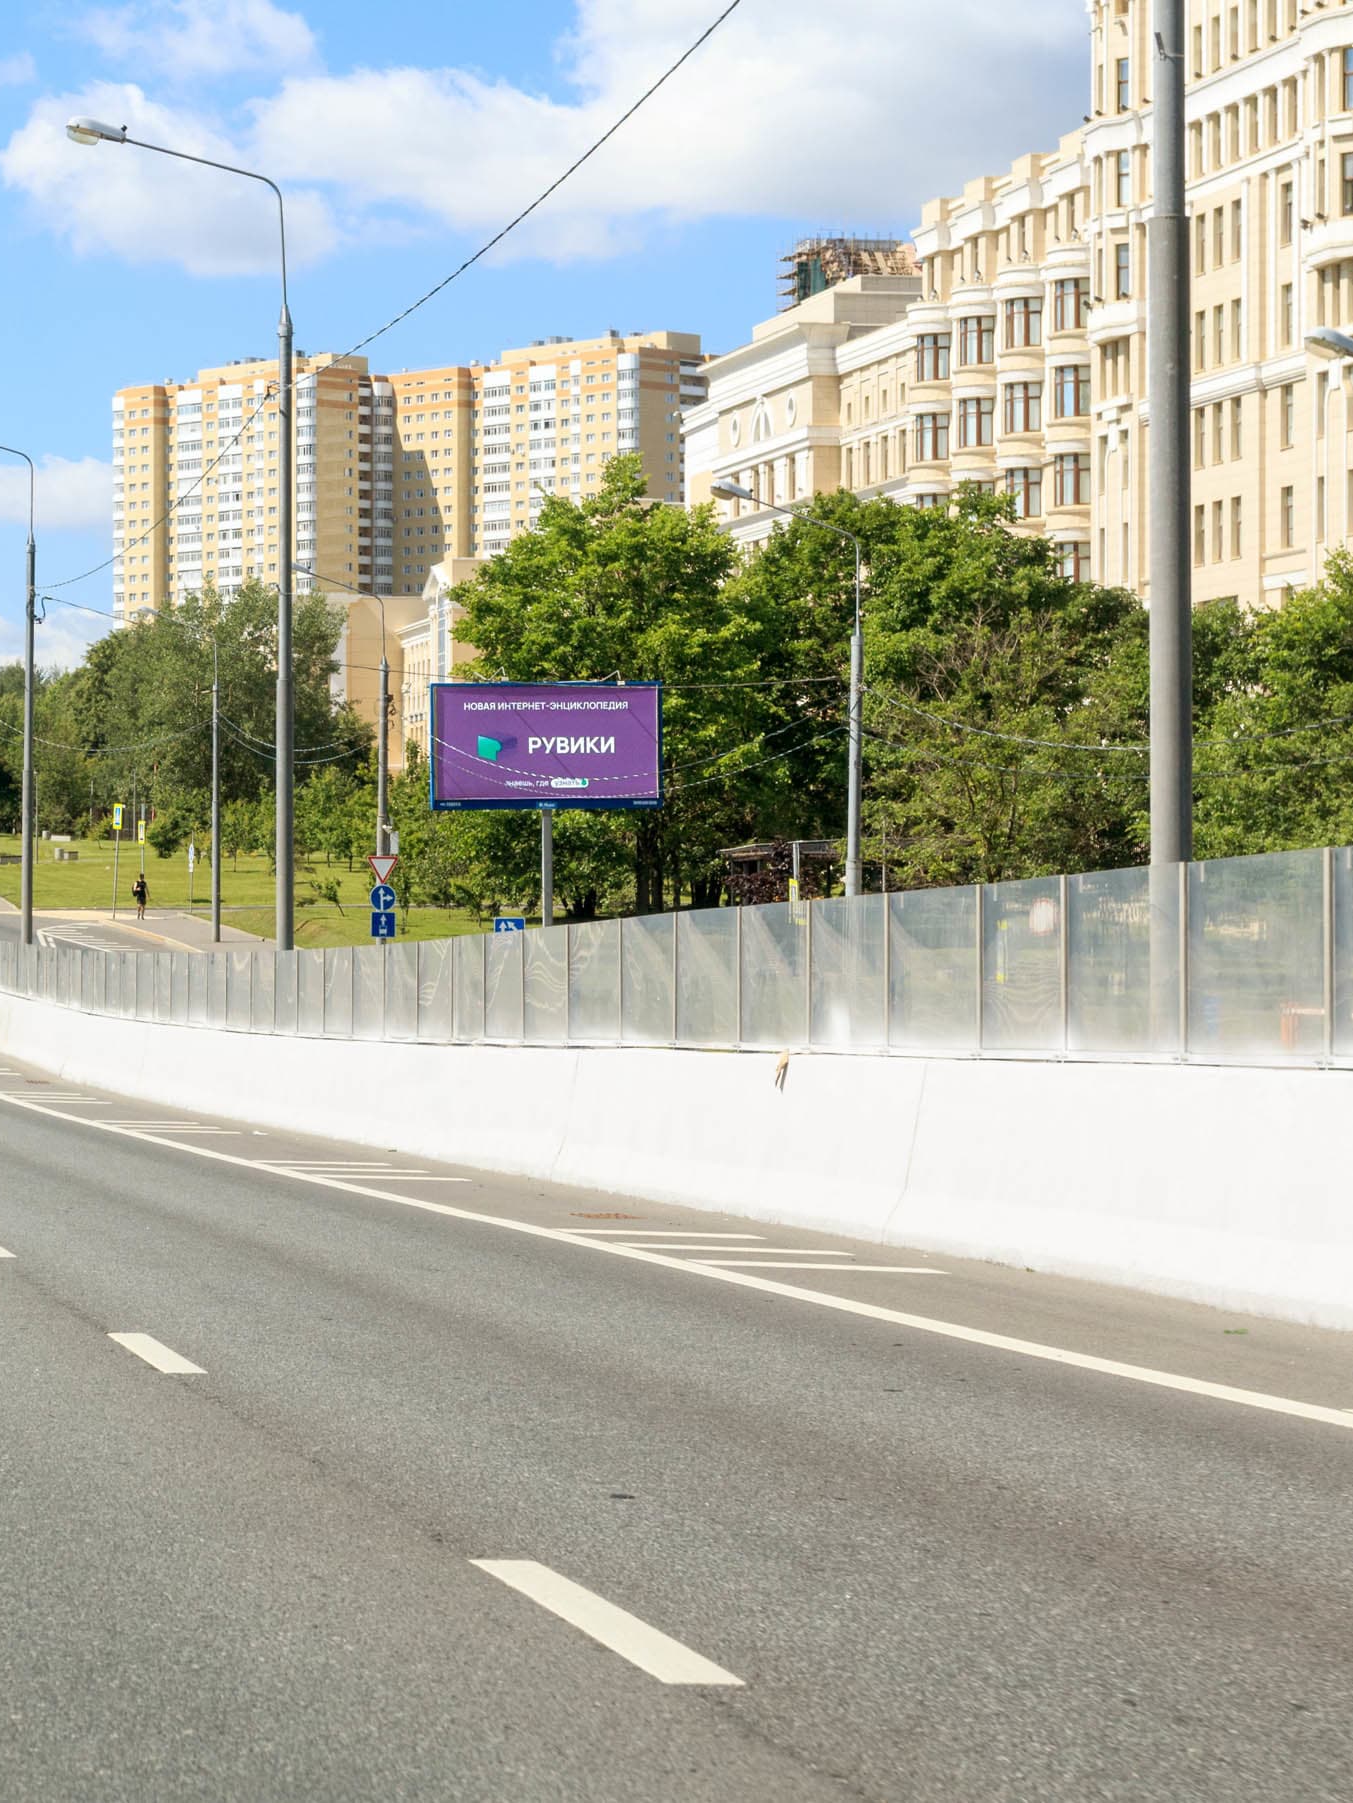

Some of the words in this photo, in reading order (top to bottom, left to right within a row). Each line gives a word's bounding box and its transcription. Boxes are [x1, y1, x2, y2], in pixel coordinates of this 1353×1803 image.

[463, 702, 496, 711] НОВАЯ
[497, 701, 629, 711] ИНТЕРНЕТ-ЭНЦИКЛОПЕДИЯ
[528, 736, 616, 754] РУВИКИ
